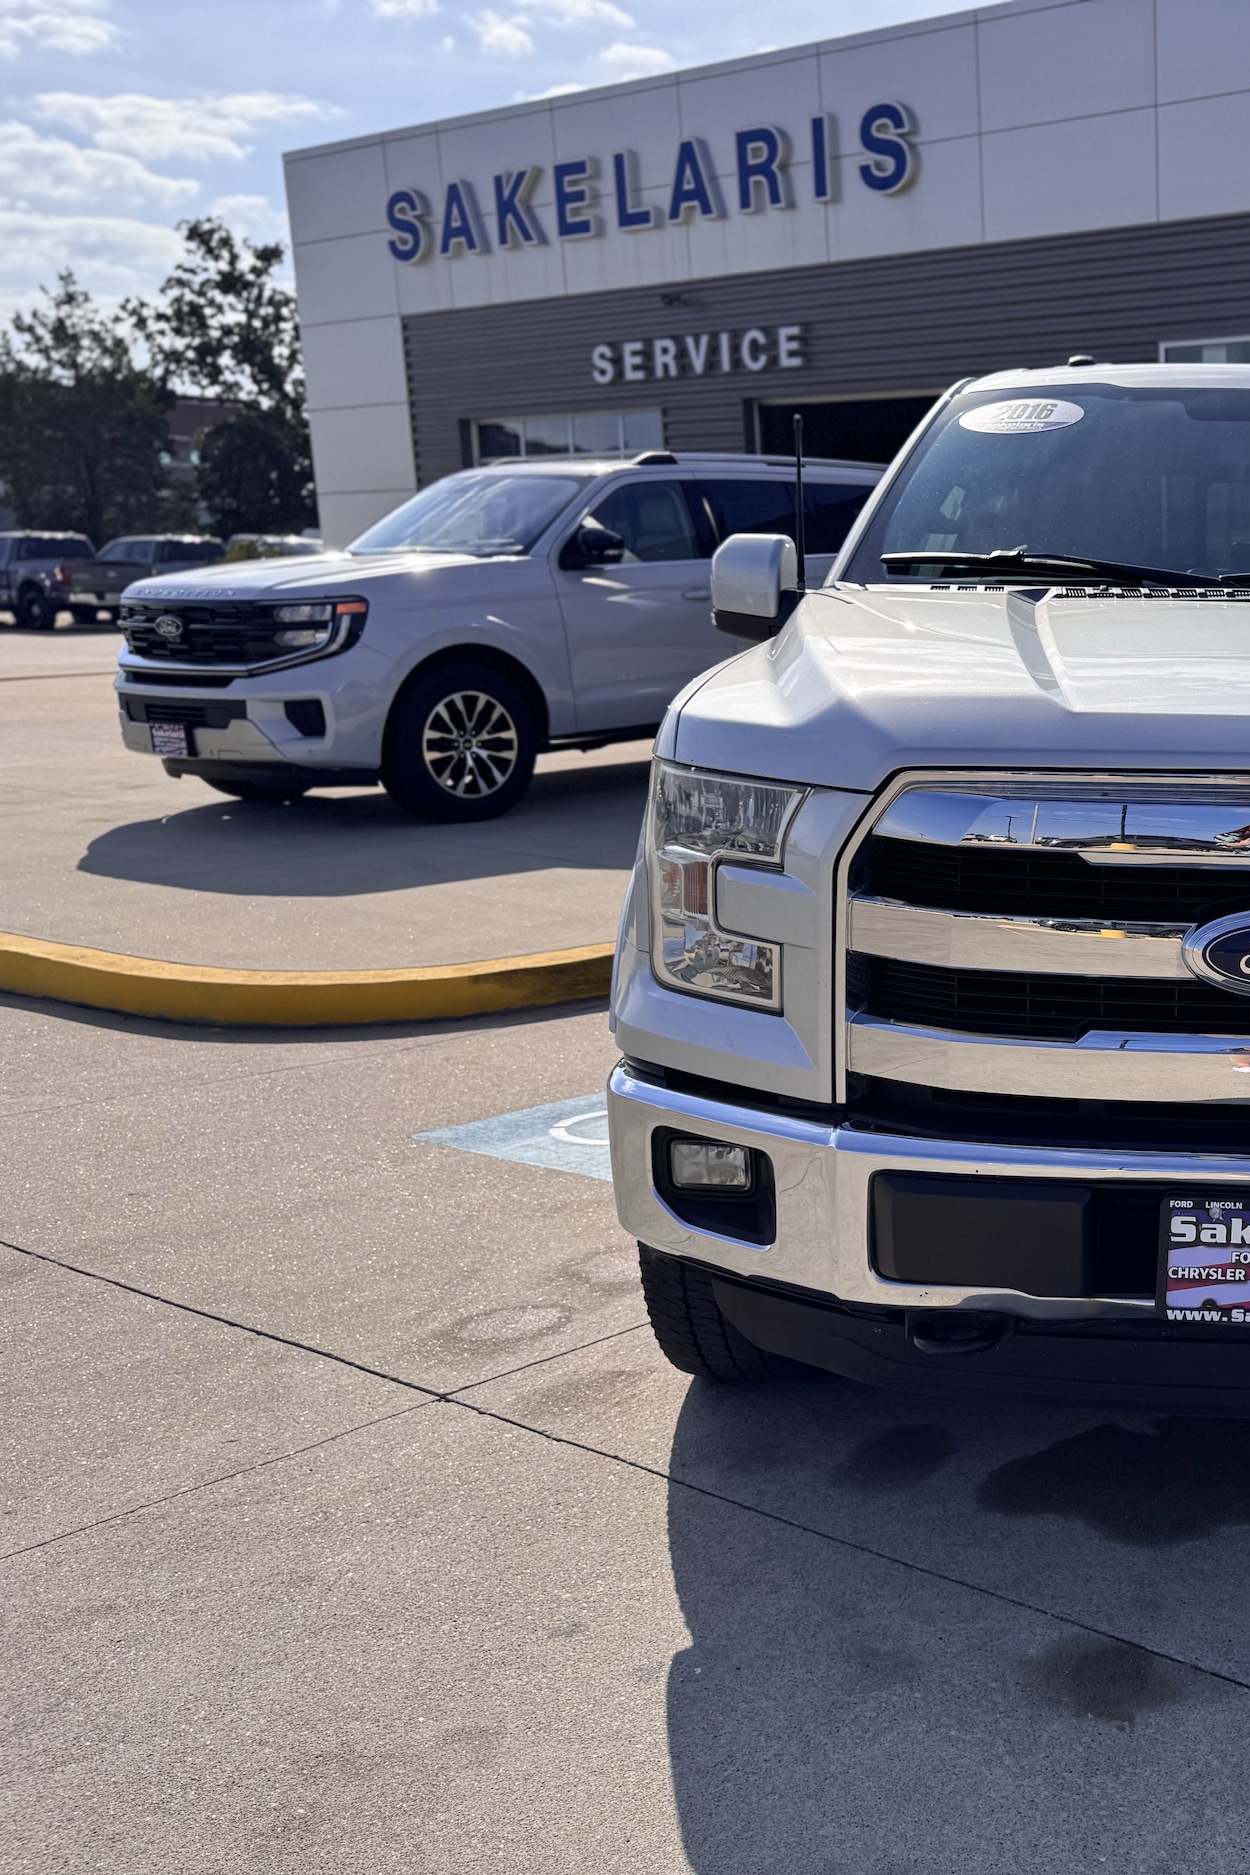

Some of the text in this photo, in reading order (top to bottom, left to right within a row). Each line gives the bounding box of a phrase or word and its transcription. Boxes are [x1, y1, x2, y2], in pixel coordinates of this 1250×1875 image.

[386, 102, 914, 265] SAKELARIS
[591, 326, 804, 384] SERVICE
[992, 403, 1058, 420] 2016
[1170, 1200, 1193, 1208] FORD
[1205, 1201, 1243, 1210] LINCOLN
[1168, 1266, 1246, 1281] CHRYSLER
